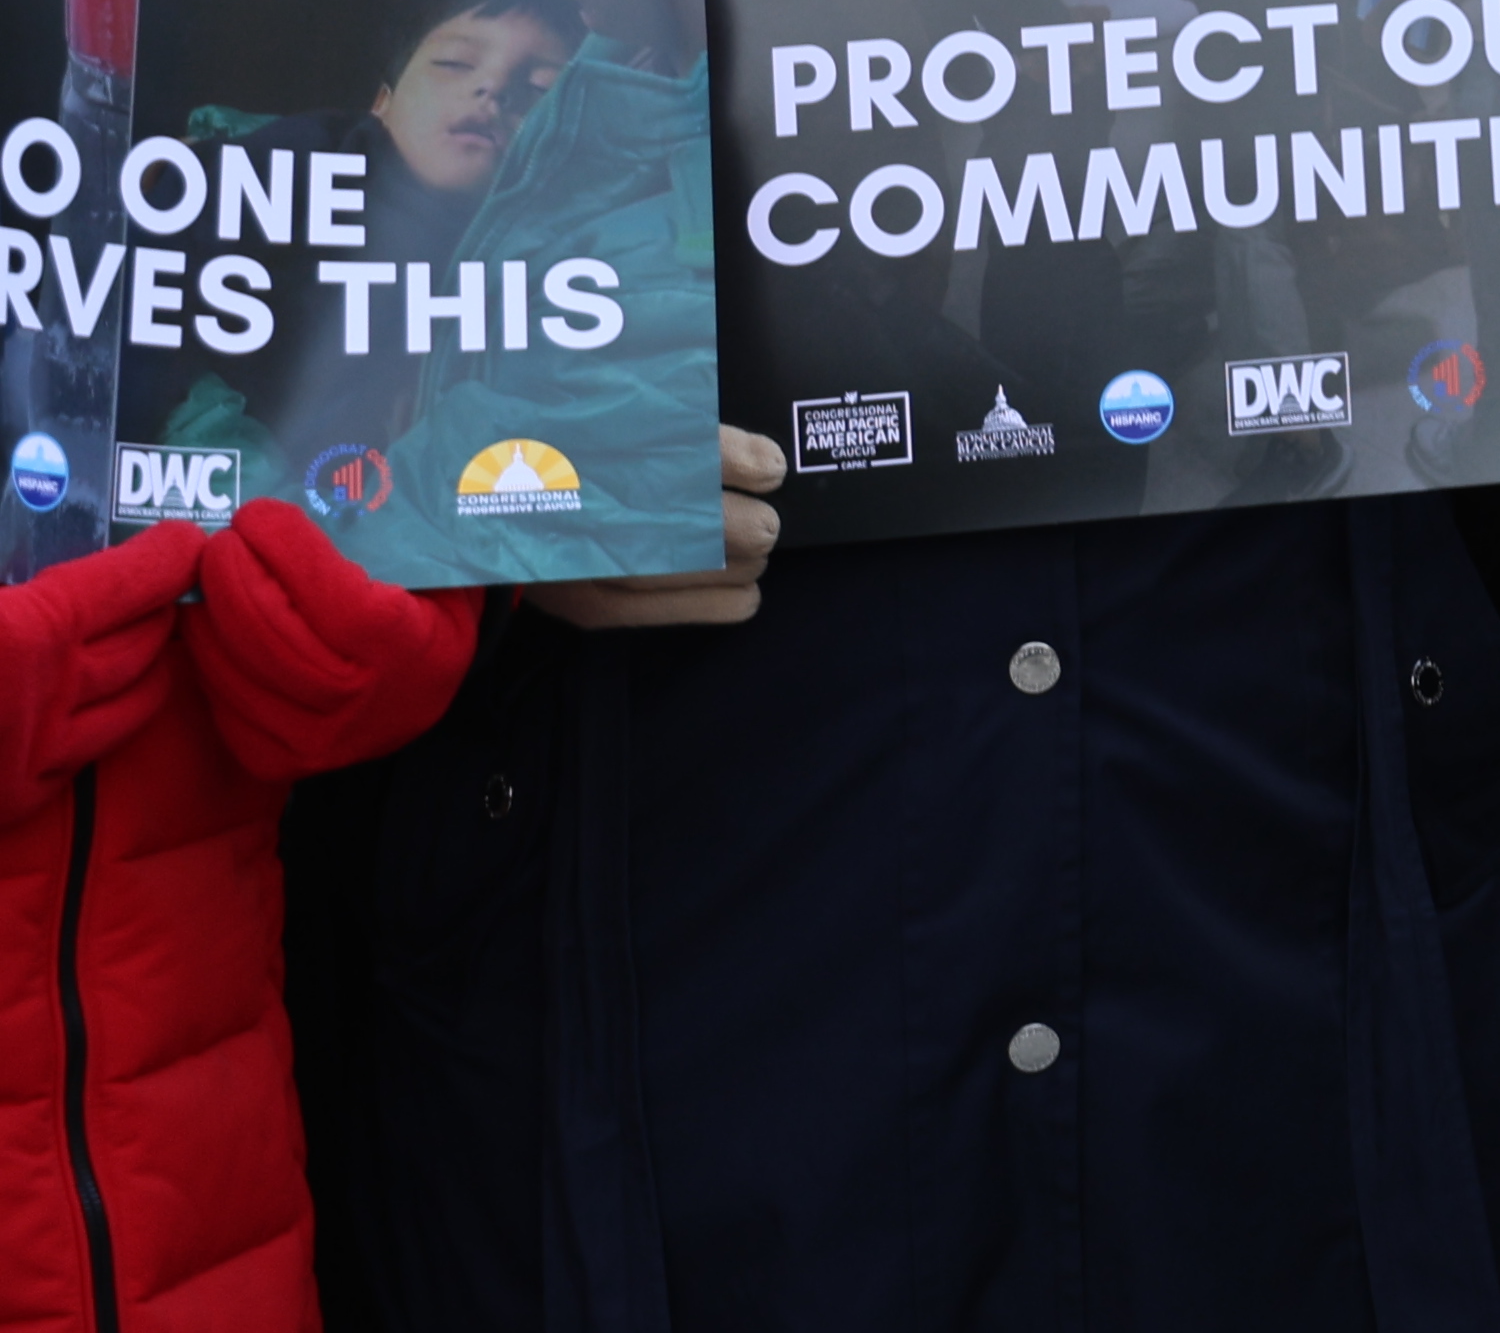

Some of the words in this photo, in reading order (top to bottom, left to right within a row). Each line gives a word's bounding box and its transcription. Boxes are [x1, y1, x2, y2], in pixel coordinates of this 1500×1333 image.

[771, 2, 1339, 137] PROTECT
[1, 117, 82, 219] O
[120, 136, 367, 247] ONE
[318, 257, 625, 354] THIS
[1232, 358, 1344, 419] DWC
[804, 403, 899, 421] CONGRESSIONAL
[1110, 411, 1162, 429] HISPANIC
[805, 417, 846, 435] ASIAN
[848, 414, 900, 432] PACIFIC
[806, 428, 900, 451] AMERICAN
[831, 445, 877, 459] CAUCUS
[119, 449, 233, 510] DWC
[457, 490, 580, 505] CONGRESSIONAL
